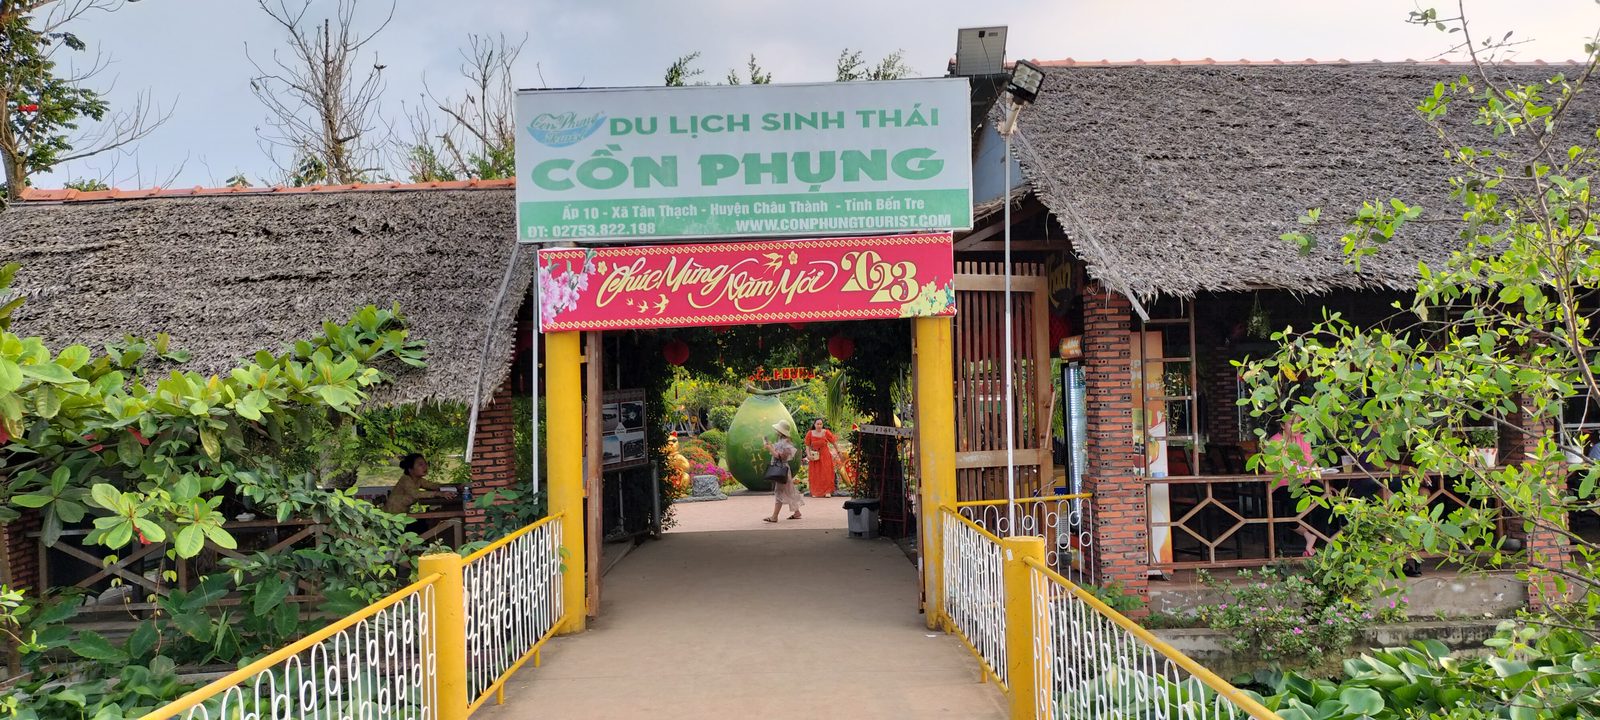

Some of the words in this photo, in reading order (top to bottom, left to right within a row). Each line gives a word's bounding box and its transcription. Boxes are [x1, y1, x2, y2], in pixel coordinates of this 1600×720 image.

[609, 116, 658, 136] DU
[669, 113, 750, 139] LỊCH
[761, 111, 845, 132] SINH
[855, 102, 939, 128] THÁI
[531, 143, 678, 191] CỒN
[697, 147, 945, 192] PHỤNG
[584, 207, 599, 219] 10
[612, 206, 629, 219] Xã
[632, 205, 656, 218] Tân
[659, 204, 698, 219] Thạch
[711, 202, 749, 217] Huyện
[753, 201, 786, 214] Châu
[789, 200, 828, 213] Thành
[845, 198, 872, 211] Tỉnh
[876, 196, 900, 210] Bến
[905, 198, 925, 210] Tre
[528, 225, 548, 238] ĐT:
[552, 222, 656, 238] 02753.822.198
[736, 214, 951, 232] WWW.CONPHUNGTOURIST.COM
[596, 256, 662, 308] Chúc
[656, 256, 759, 296] Mừng
[840, 250, 919, 303] 2023
